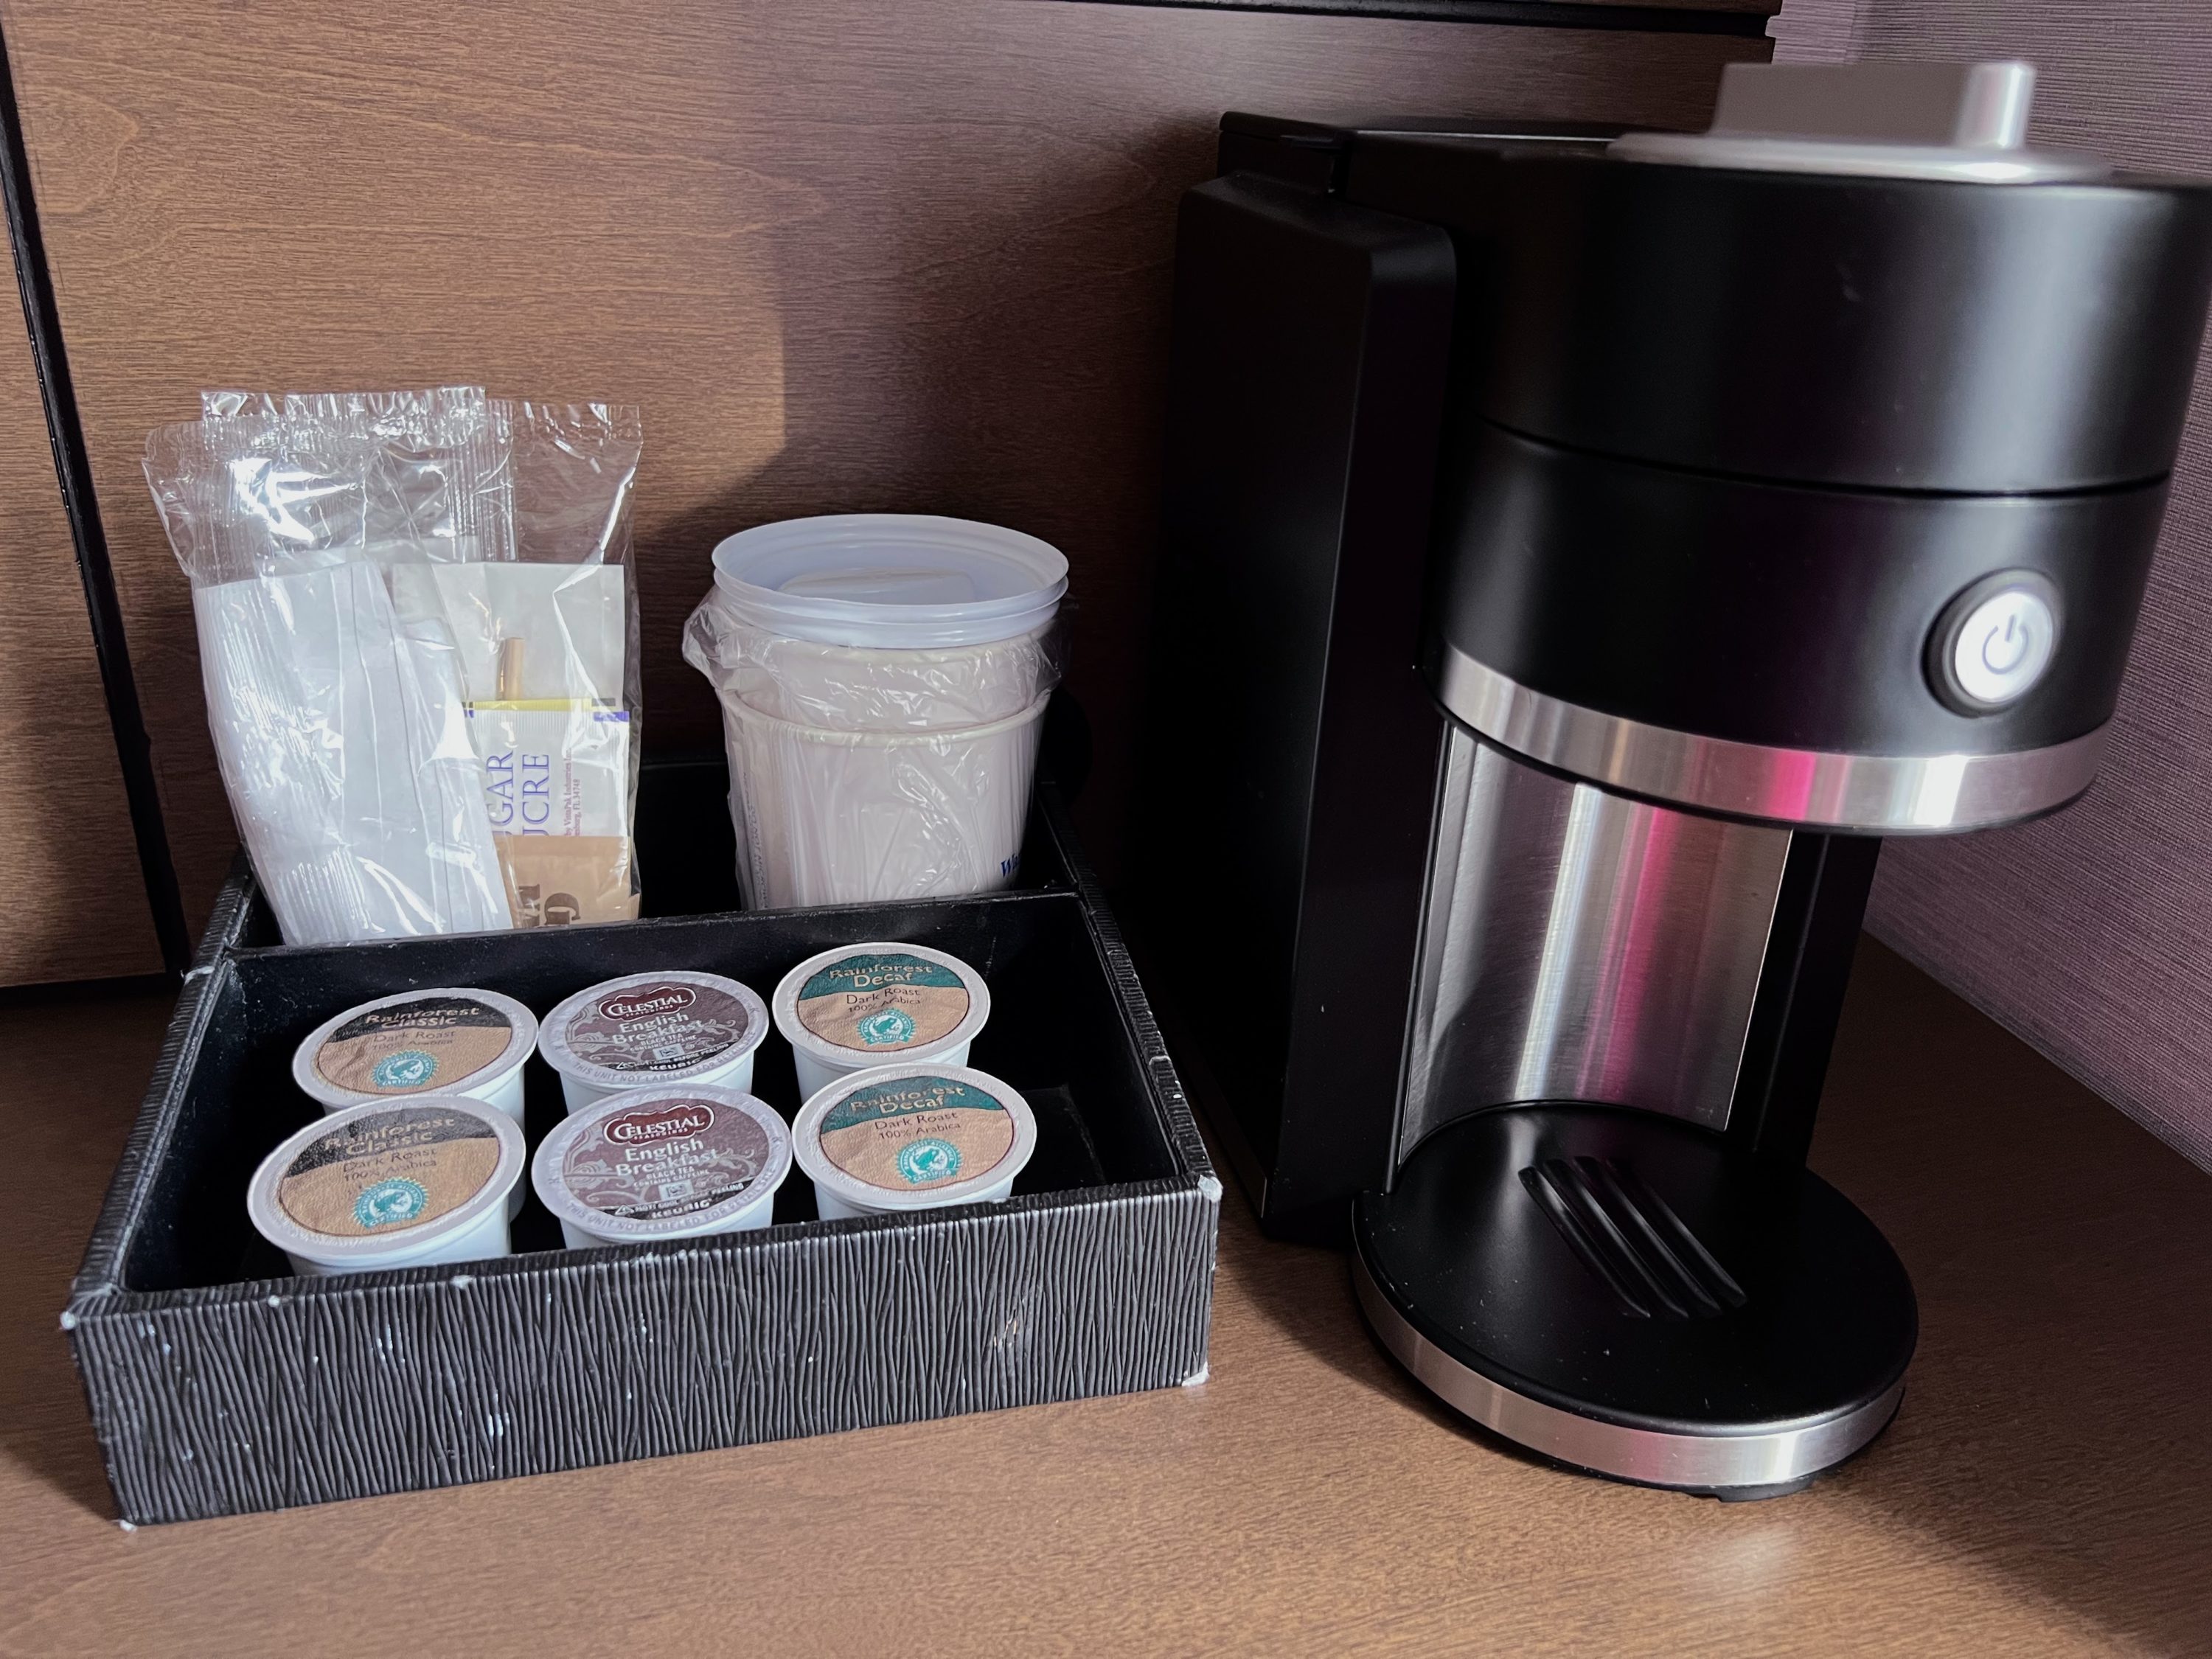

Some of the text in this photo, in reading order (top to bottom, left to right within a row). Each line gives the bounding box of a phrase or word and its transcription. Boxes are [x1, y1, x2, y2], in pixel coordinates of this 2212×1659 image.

[830, 964, 932, 978] Rainforest
[854, 972, 914, 987] Decaf
[846, 987, 920, 1004] Dark Roast
[848, 996, 920, 1012] 100% Arabica
[608, 995, 688, 1016] CELESTIAL
[366, 1007, 479, 1024] Rainforest
[381, 1016, 457, 1028] Classic
[619, 1012, 689, 1032] English
[374, 1031, 455, 1043] Dark Roast
[612, 1020, 704, 1044] Breakfast
[641, 1032, 683, 1045] BLACK TEA
[630, 1042, 664, 1051] CONTAINS
[574, 1062, 593, 1074] THIS
[594, 1071, 616, 1081] UNIT
[646, 1070, 693, 1082] LABELED
[851, 1087, 965, 1112] Rainforest
[880, 1094, 945, 1113] Decaf
[614, 1115, 705, 1140] CELESTIAL
[874, 1112, 959, 1130] Dark Roast
[878, 1123, 961, 1139] 100% Arabica
[346, 1130, 433, 1155] Classic
[625, 1138, 703, 1161] English
[344, 1148, 437, 1172] Dark Roast
[616, 1148, 720, 1176] Breakfast
[646, 1166, 695, 1180] BLACK TEA
[633, 1178, 671, 1187] CONTAINS
[589, 1215, 612, 1228] UNIT
